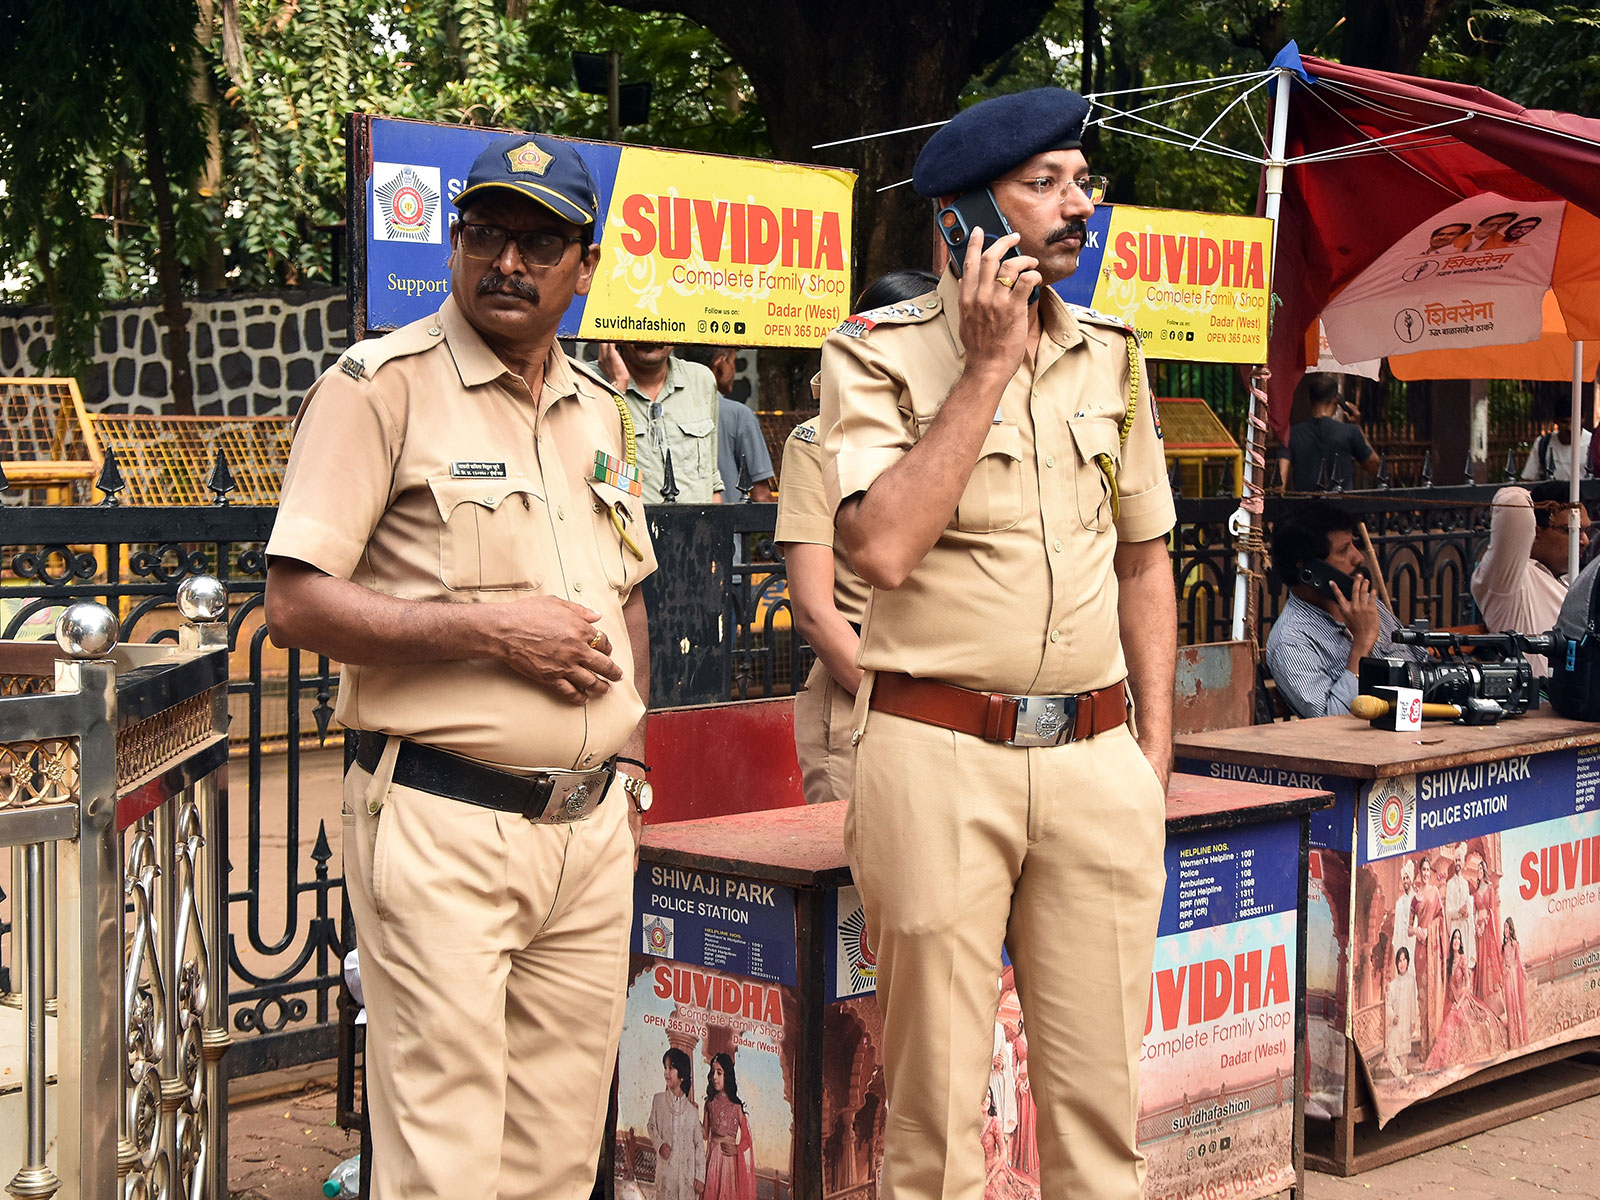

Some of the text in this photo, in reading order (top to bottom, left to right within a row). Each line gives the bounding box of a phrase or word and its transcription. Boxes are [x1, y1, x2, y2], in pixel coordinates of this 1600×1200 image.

[620, 194, 844, 270] SUVIDHA
[1114, 231, 1265, 290] SUVIDHA
[1442, 252, 1514, 270] शिवसेना
[387, 272, 448, 297] Support
[672, 265, 846, 297] Complete Family Shop
[1146, 286, 1265, 311] Complete Family Shop
[704, 306, 722, 315] Follow
[767, 302, 840, 323] Dadar (West)
[1424, 300, 1494, 326] शिवसेना
[594, 316, 686, 332] suvidhafashion
[764, 323, 792, 337] OPEN
[794, 324, 812, 338] 365
[1166, 318, 1178, 327] Follow
[1210, 315, 1261, 331] Dadar (West)
[1475, 321, 1494, 332] ठाकरे
[1207, 332, 1260, 345] OPEN 365 DAYS
[1411, 701, 1420, 721] Tak
[1210, 762, 1324, 790] SHIVAJI PARK
[1421, 755, 1531, 801] SHIVAJI PARK
[1420, 805, 1461, 831] POLICE
[1463, 794, 1508, 820] STATION
[1179, 856, 1208, 868] Women's
[1210, 852, 1235, 864] Helpline
[1241, 849, 1255, 859] 1091
[1180, 842, 1229, 858] HELPLINE NOS.
[1179, 869, 1199, 879] Police
[1241, 859, 1252, 868] 100
[1519, 835, 1600, 901] SUVI
[651, 866, 776, 907] SHIVAJI PARK
[1179, 876, 1215, 889] Ambulance
[1179, 888, 1197, 900] Child
[1197, 885, 1223, 897] Helpline
[651, 894, 749, 925] POLICE STATION
[1179, 899, 1193, 910] RPF
[1193, 896, 1209, 907] (WR)
[1240, 888, 1254, 898] 1311
[1179, 910, 1193, 920] RPF
[1193, 906, 1208, 919] (CR)
[1240, 898, 1255, 908] 1275
[1547, 890, 1596, 914] Complete
[1179, 919, 1194, 930] GRP
[653, 965, 785, 1026] SUVIDHA
[643, 1014, 708, 1038] OPEN 365 DAYS
[678, 1005, 785, 1041] Complete Family Shop
[1212, 1016, 1256, 1044] Family
[1258, 1009, 1291, 1033] Shop
[733, 1034, 782, 1057] Dadar (West)
[1220, 1038, 1287, 1070] Dadar (West)
[1172, 1098, 1251, 1131] suvidhafashion
[1193, 1128, 1210, 1139] Follow
[1196, 1160, 1279, 1200] 365 DAYS
